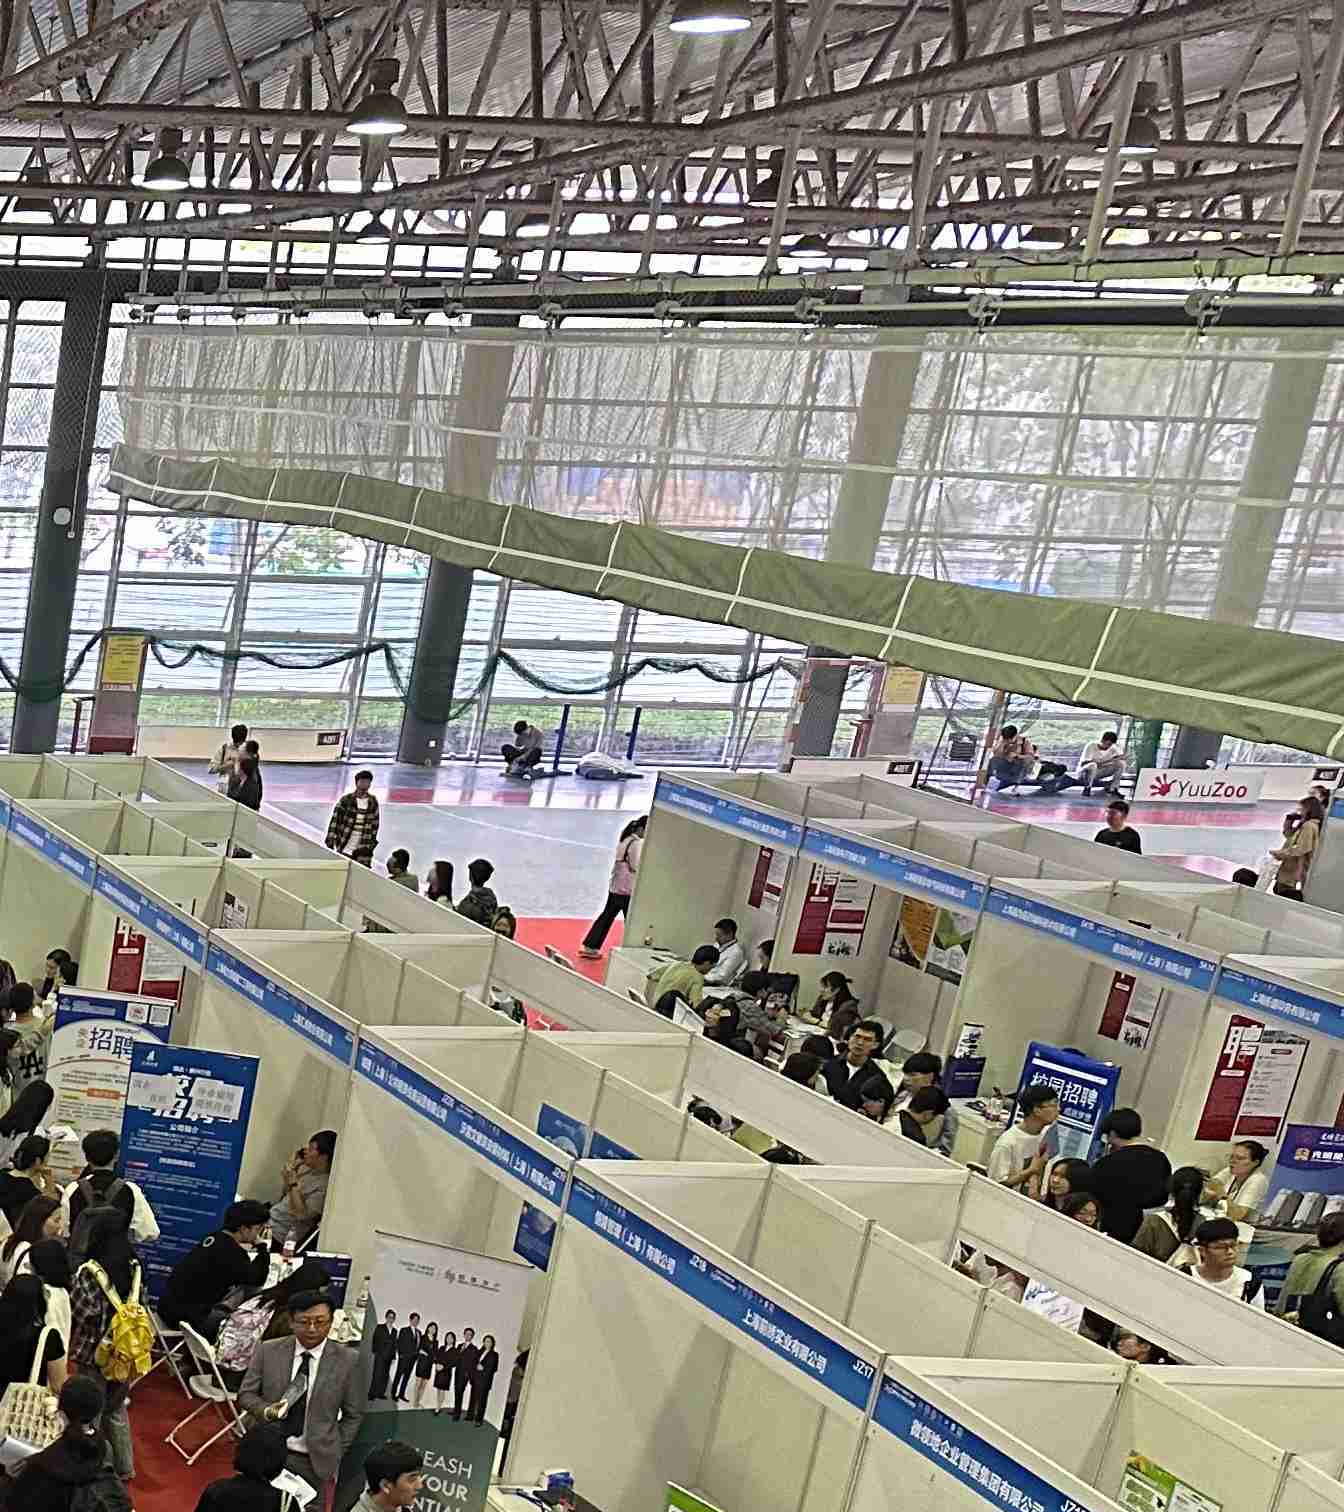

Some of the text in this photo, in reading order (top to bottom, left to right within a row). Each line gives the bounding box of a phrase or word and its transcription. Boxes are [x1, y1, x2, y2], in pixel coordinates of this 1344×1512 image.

[1176, 776, 1248, 798] YuuZoo
[852, 1359, 875, 1380] JZ17
[416, 1447, 472, 1480] EASH
